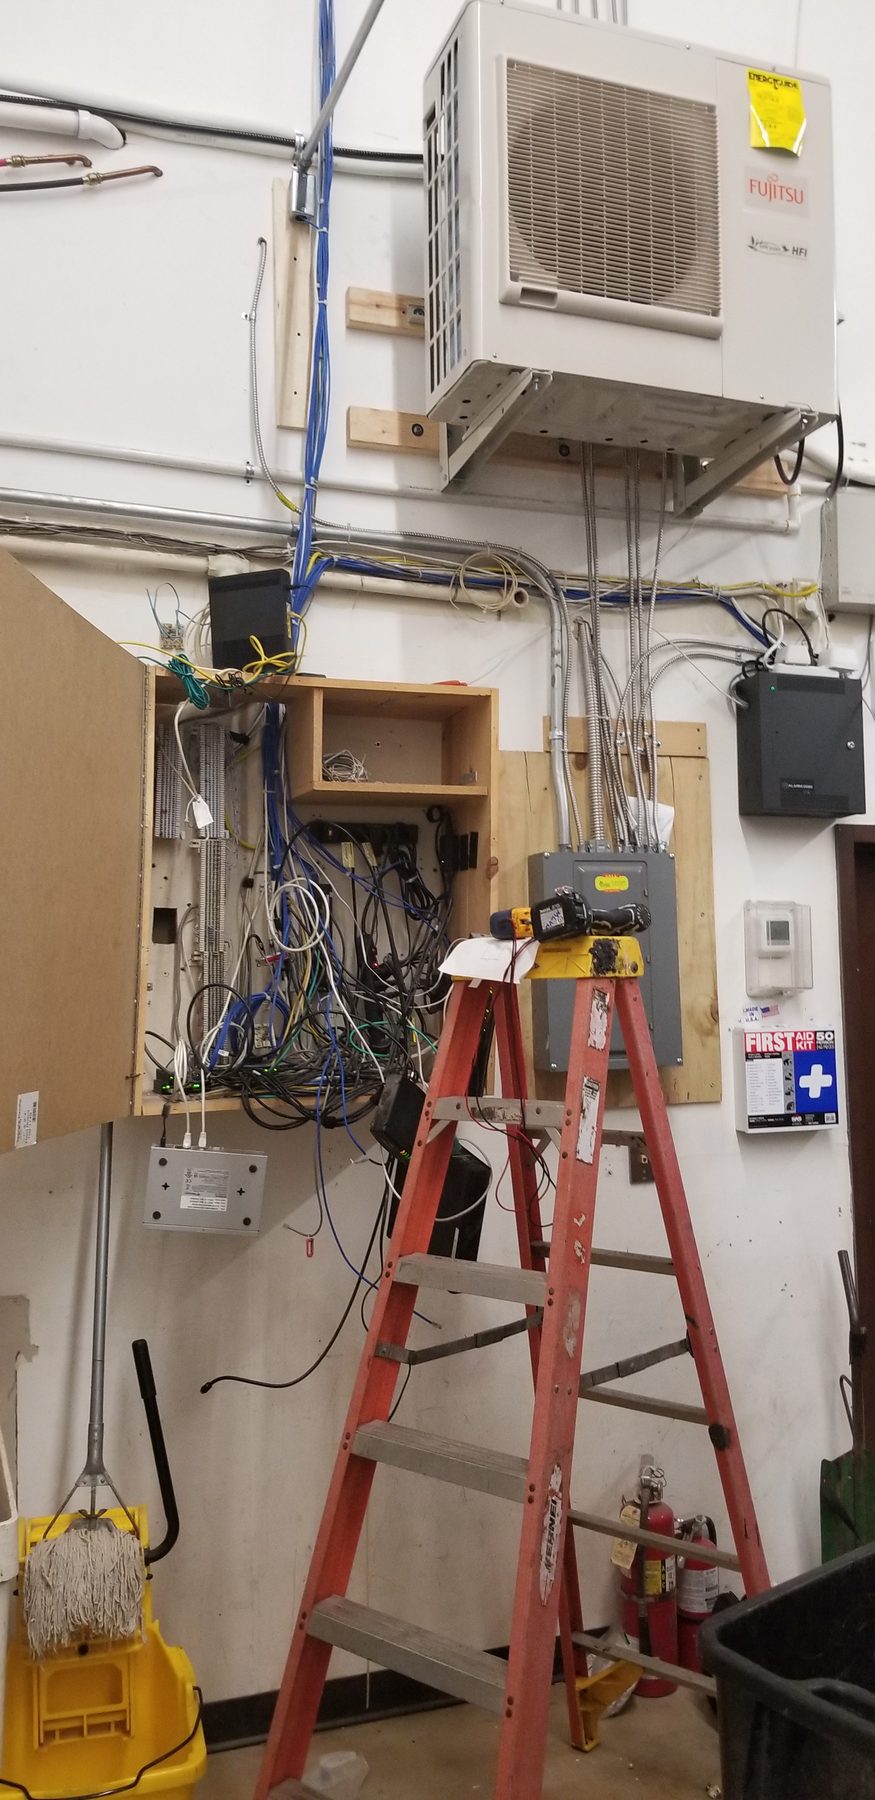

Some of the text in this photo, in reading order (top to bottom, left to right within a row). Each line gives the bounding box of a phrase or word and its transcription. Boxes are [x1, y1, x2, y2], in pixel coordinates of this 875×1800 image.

[750, 177, 804, 204] FUJITSU
[745, 1031, 815, 1052] FIRST AID
[816, 1031, 834, 1041] 50
[796, 1041, 814, 1050] KIT
